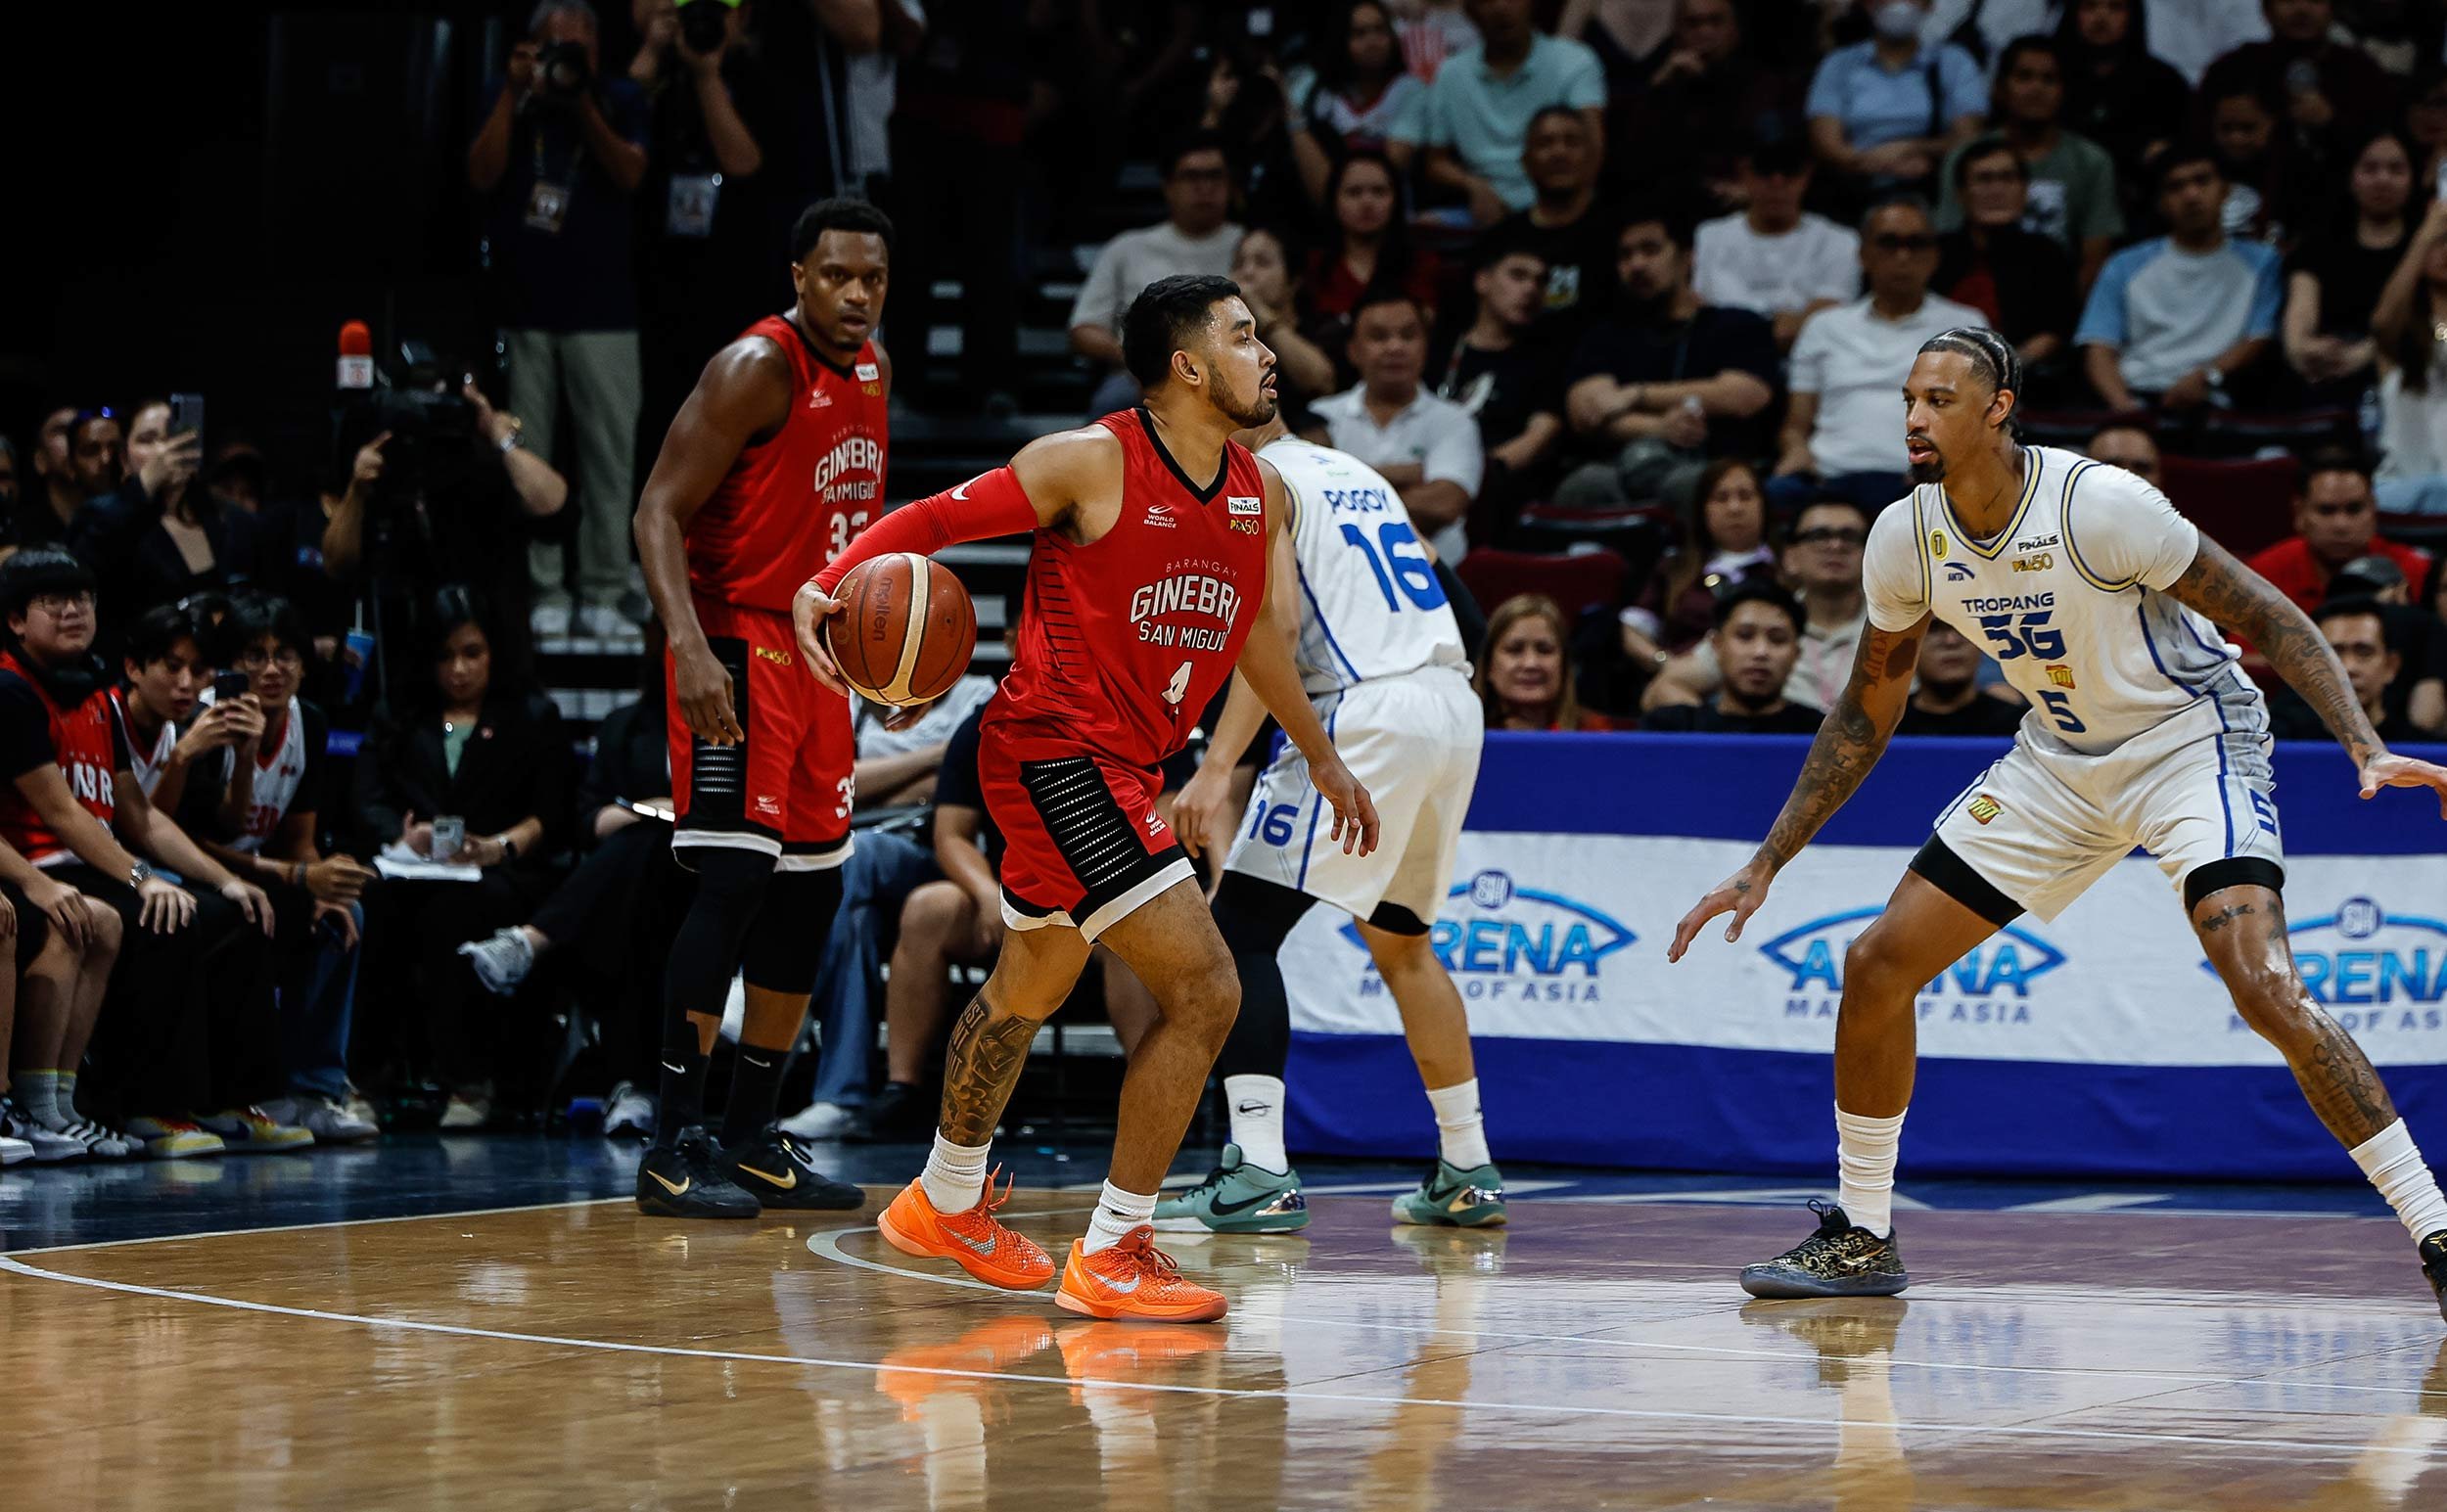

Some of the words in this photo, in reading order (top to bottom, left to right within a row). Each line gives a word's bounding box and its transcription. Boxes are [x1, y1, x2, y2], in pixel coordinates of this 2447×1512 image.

[1324, 489, 1392, 514] POGOY
[1143, 520, 1177, 528] BALANCE
[1147, 514, 1175, 523] WORLD
[1166, 558, 1238, 579] BARANGAY
[1339, 522, 1450, 613] 16
[1962, 591, 2055, 614] TROPANG
[1138, 620, 1176, 647] SAN
[1973, 610, 2068, 661] 5G
[1160, 660, 1193, 706] 4
[2037, 689, 2087, 733] 5
[1967, 797, 2002, 820] TNT
[1249, 799, 1300, 847] 16
[1364, 920, 1599, 977] RENA
[1467, 981, 1507, 1001] OF
[1521, 983, 1600, 1003] ASIA
[1785, 999, 1833, 1019] MA
[1919, 1002, 1935, 1020] F
[1950, 1004, 2030, 1023] ASIA
[2340, 1011, 2381, 1032] OF
